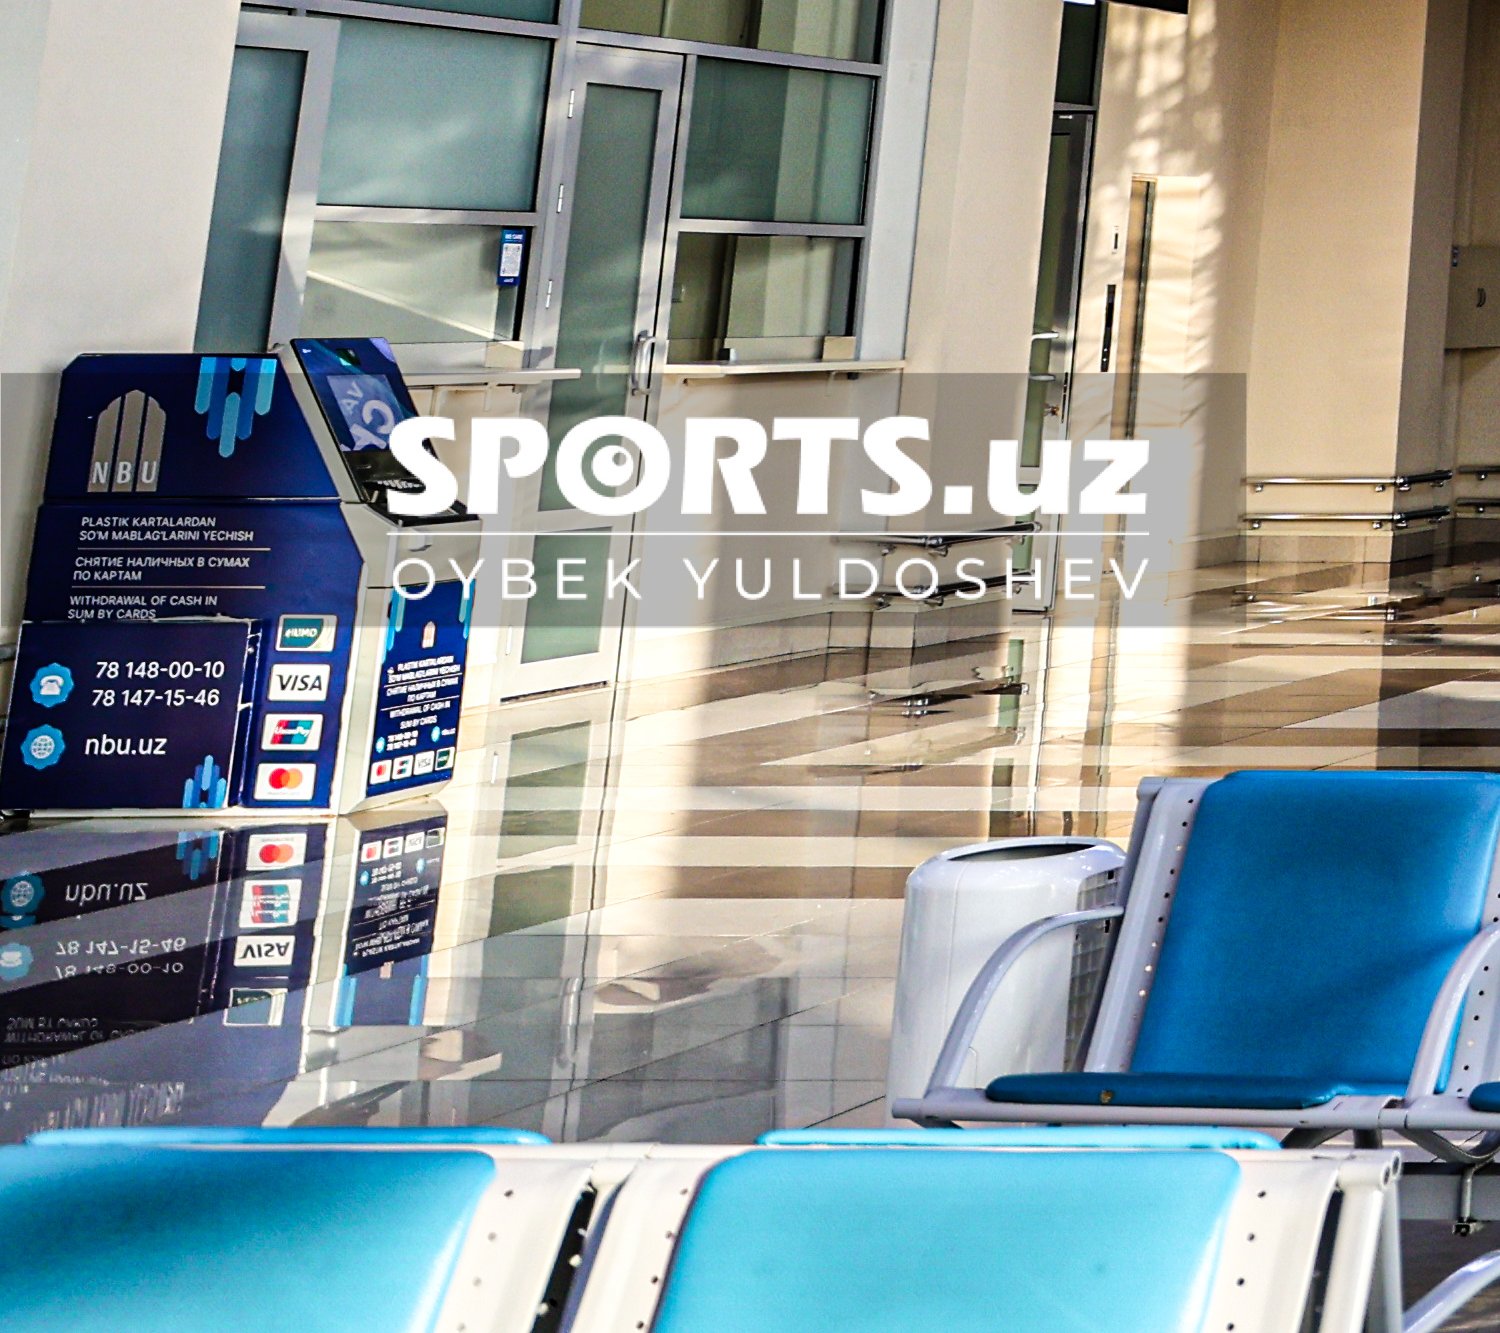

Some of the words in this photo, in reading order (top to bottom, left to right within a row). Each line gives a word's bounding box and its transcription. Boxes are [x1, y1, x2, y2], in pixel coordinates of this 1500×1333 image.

[91, 460, 158, 484] NBU
[81, 517, 129, 527] PLASTIK
[132, 516, 216, 527] KARTALARDAN
[203, 530, 254, 542] YECHISH
[75, 556, 123, 567] СНЯТИЕ
[126, 556, 194, 567] НАЛИЧНЫХ
[197, 556, 205, 567] В
[208, 556, 250, 567] СУМАХ
[73, 570, 91, 581] ПО
[93, 570, 142, 581] КАРТАМ
[69, 595, 147, 606] WITHDRAWAL
[150, 595, 166, 606] OF
[169, 595, 201, 606] CASH
[205, 595, 217, 606] IN
[67, 609, 94, 619] SUM
[97, 609, 113, 619] BY
[116, 609, 156, 619] CARDS
[95, 661, 120, 679] 78
[125, 660, 226, 679] 148-00-10
[276, 674, 323, 692] VISA
[91, 689, 116, 707] 78
[121, 689, 220, 707] 147-15-46
[84, 734, 168, 756] nbu.uz
